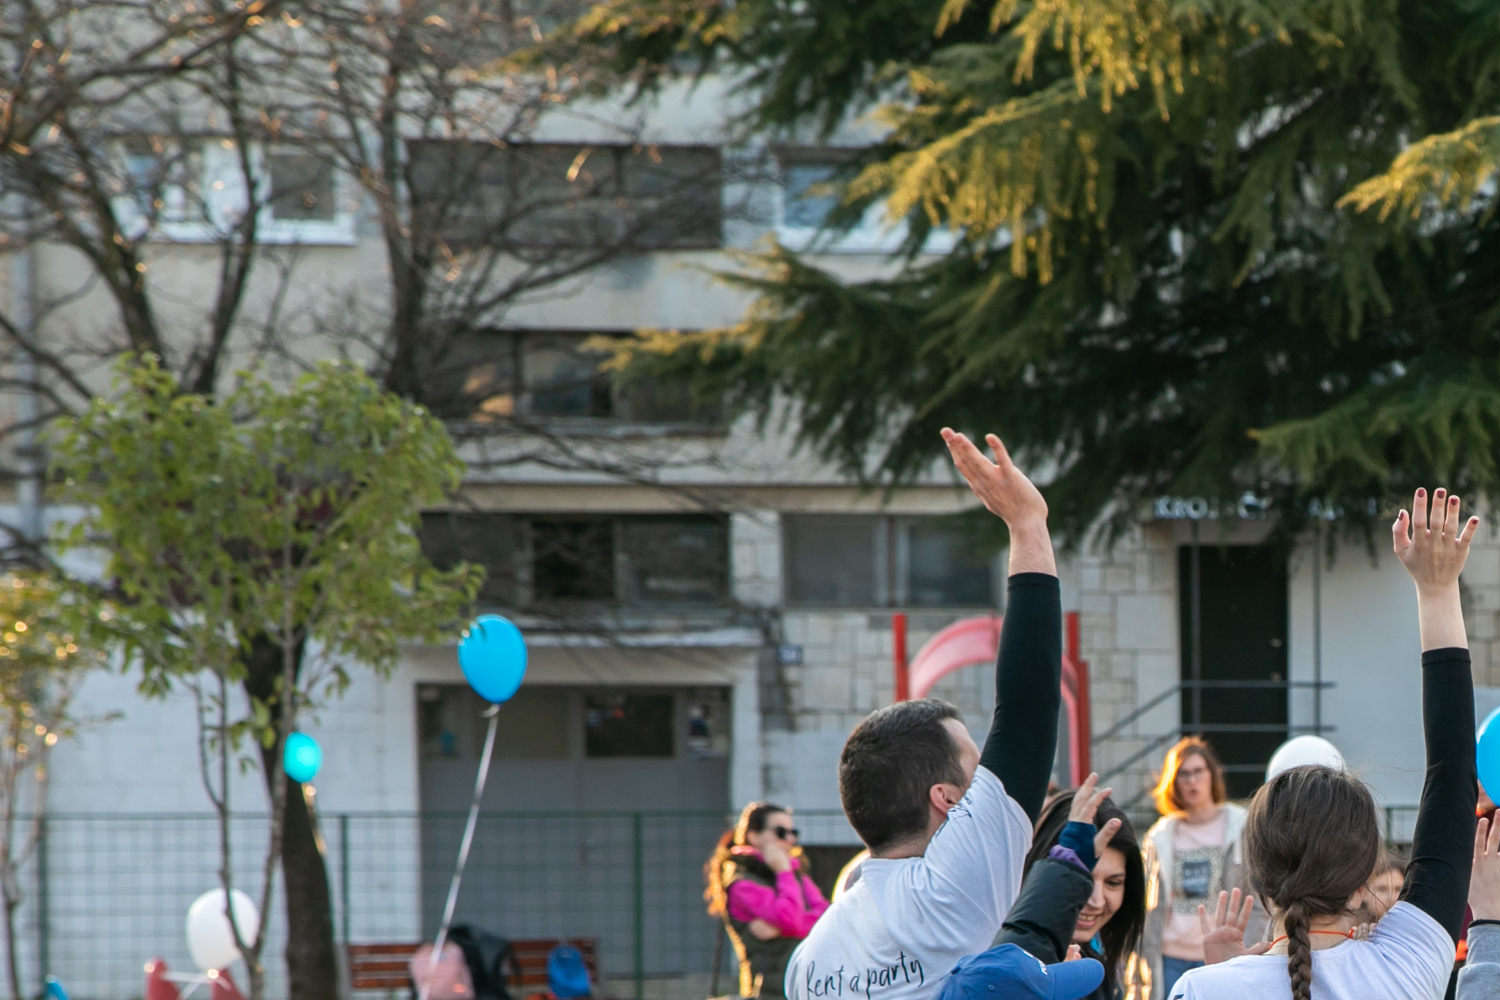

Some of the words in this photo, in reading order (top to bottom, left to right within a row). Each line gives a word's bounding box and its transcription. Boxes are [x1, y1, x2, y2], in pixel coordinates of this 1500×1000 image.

[806, 960, 845, 1000] Rent
[849, 973, 860, 992] a
[866, 950, 925, 1000] party
